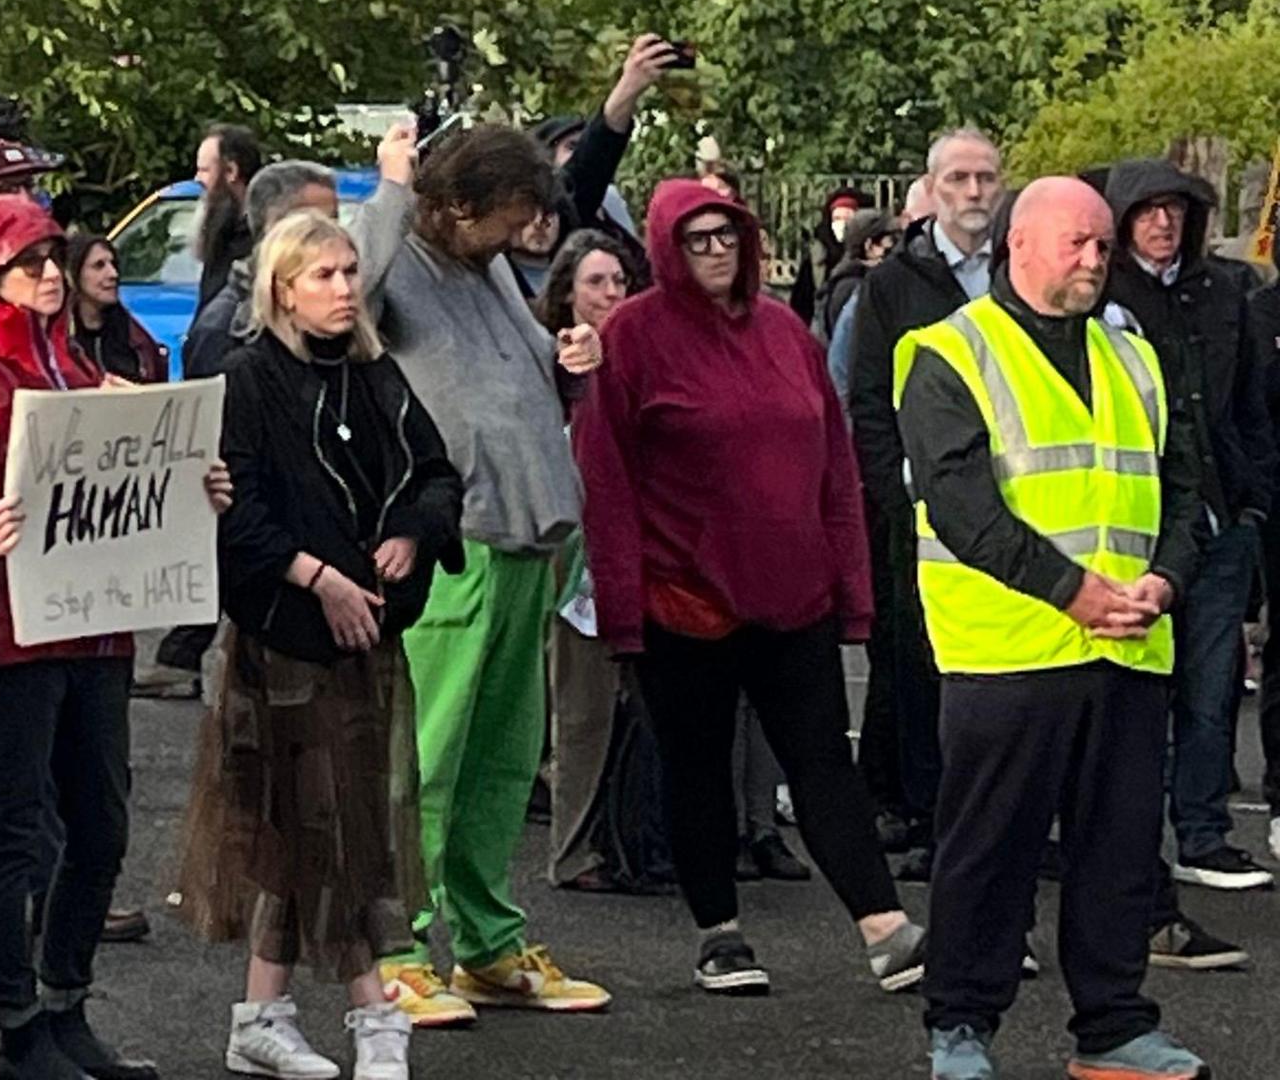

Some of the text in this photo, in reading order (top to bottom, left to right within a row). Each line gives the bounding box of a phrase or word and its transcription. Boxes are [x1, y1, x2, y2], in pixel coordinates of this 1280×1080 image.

[25, 396, 207, 484] We are ALL
[42, 467, 172, 556] HUMAN
[104, 573, 133, 608] the
[143, 560, 207, 609] HATE
